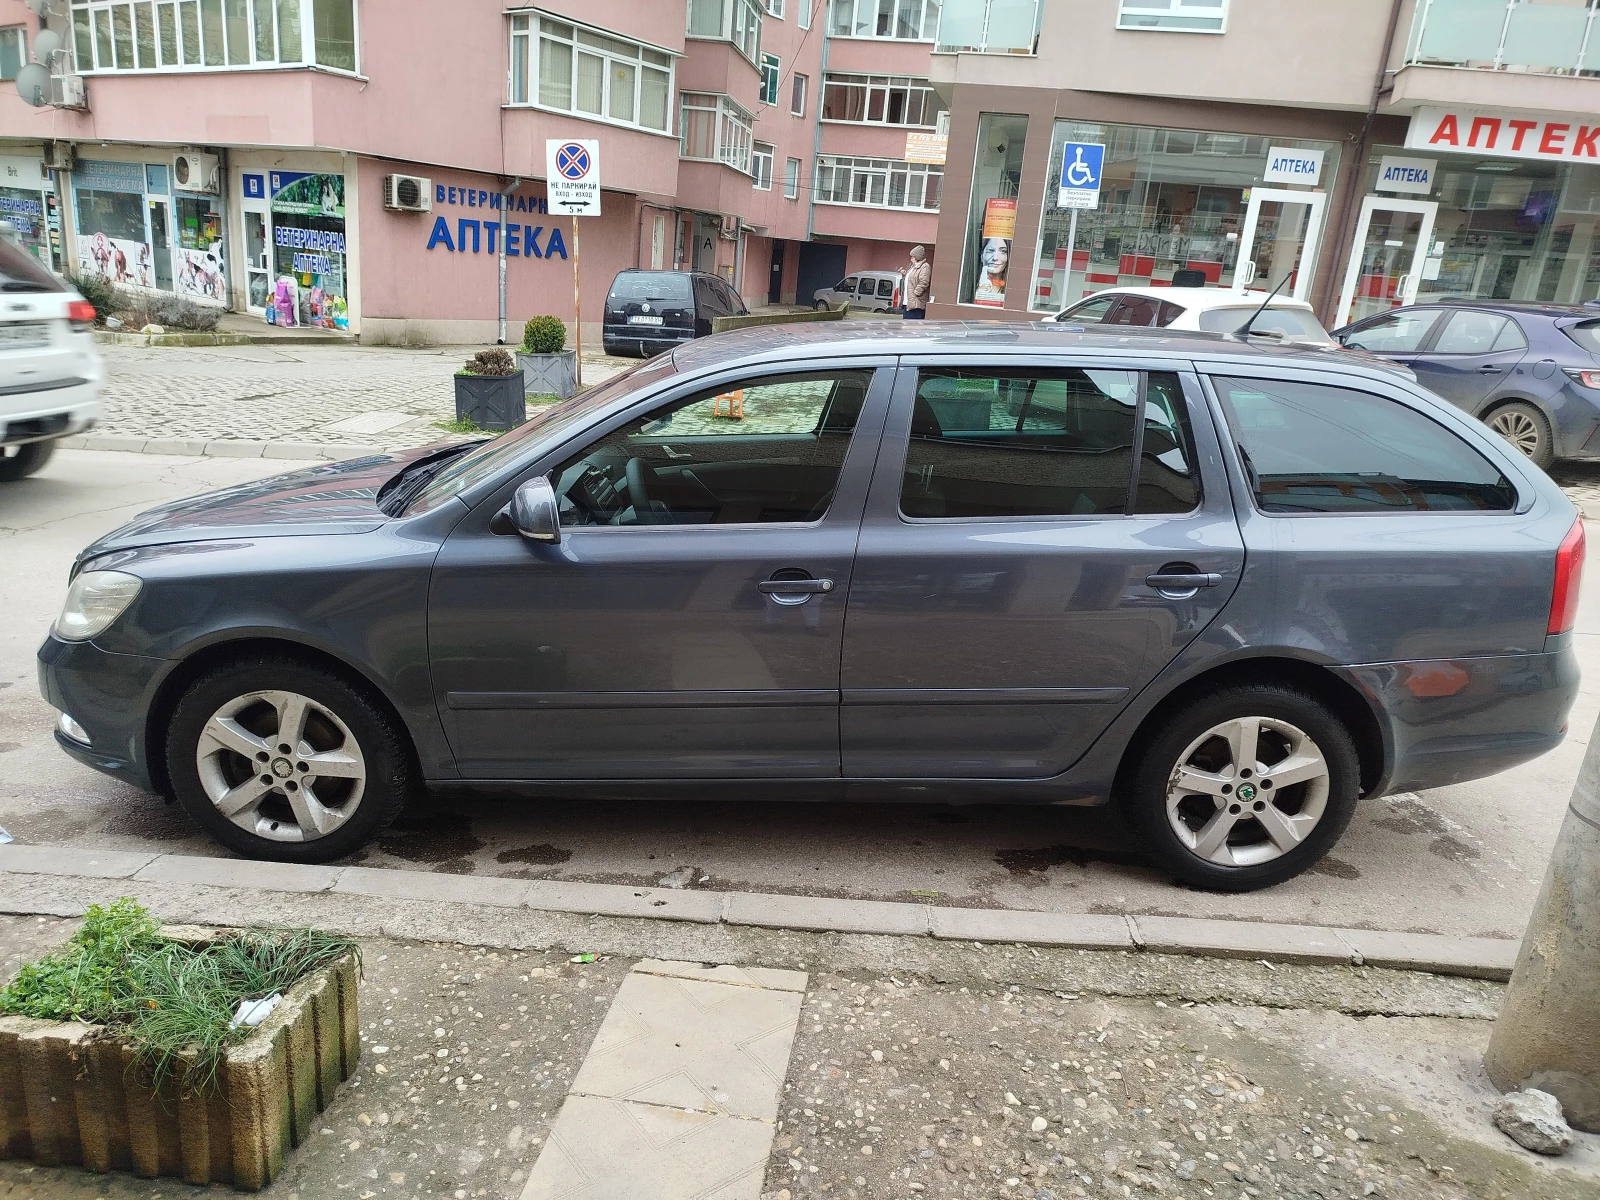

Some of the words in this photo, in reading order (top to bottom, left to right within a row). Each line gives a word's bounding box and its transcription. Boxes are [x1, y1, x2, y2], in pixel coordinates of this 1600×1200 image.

[1428, 114, 1600, 157] АПТЕК
[84, 163, 143, 178] ВЕТЕРИНАРНА
[1271, 157, 1315, 175] АПТЕКА
[1383, 166, 1428, 184] АПТЕКА
[556, 190, 570, 198] ВХОД
[576, 191, 593, 199] ИЗХОД
[561, 182, 597, 190] ПАРКИРАЙ
[275, 226, 346, 254] ВЕТЕРИНАРНА
[427, 216, 569, 259] АПТЕКА
[293, 252, 331, 275] АПТЕКА
